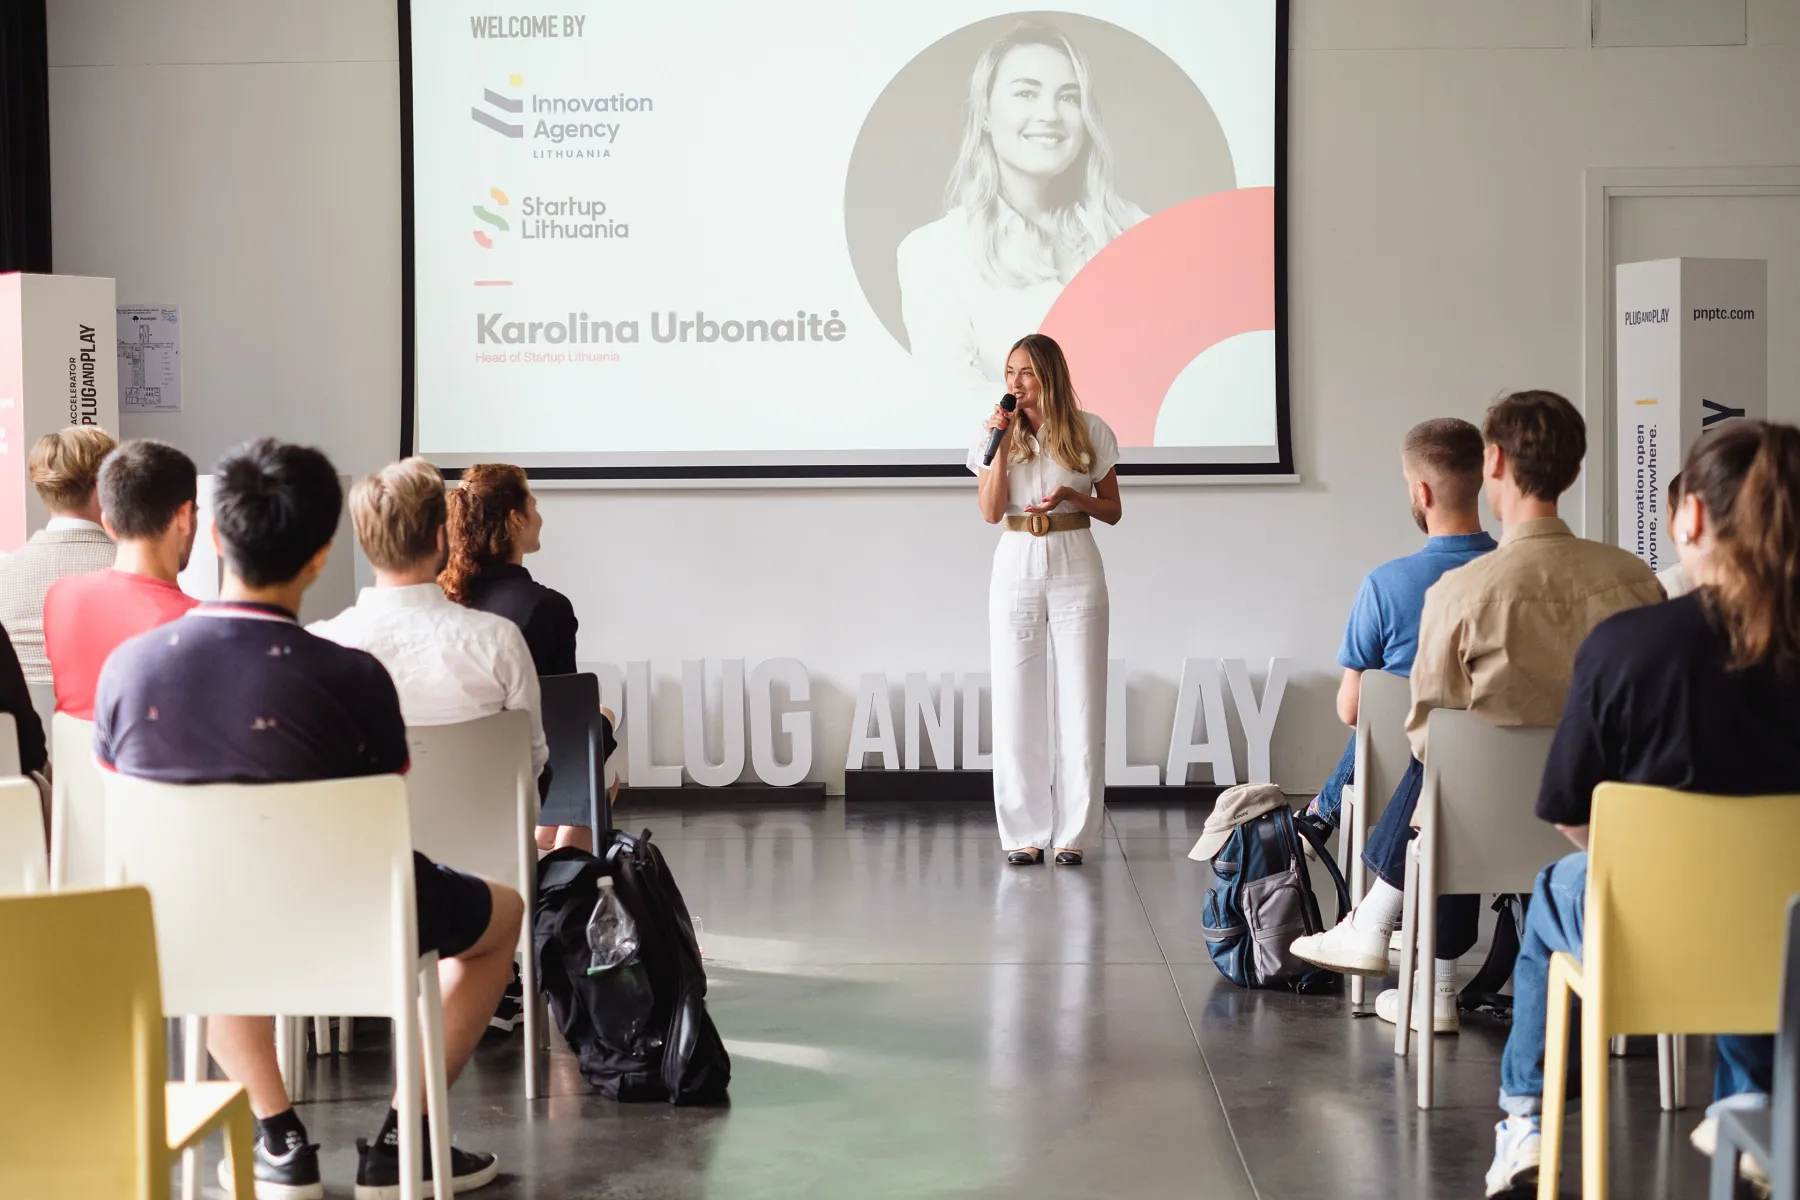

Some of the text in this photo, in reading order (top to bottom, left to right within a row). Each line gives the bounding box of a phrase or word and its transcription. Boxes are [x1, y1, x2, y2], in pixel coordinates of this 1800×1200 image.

[470, 15, 586, 38] WELCOME BY
[532, 93, 654, 114] Innovation
[533, 120, 620, 143] Agency
[533, 149, 612, 159] LITHUANIA
[521, 196, 607, 221] Startup
[521, 219, 630, 239] Lithuania
[1693, 308, 1755, 321] pnptc.com
[476, 309, 847, 345] Karolina Urbonaitė
[475, 352, 620, 365] Head of Startup Lithuania
[69, 357, 78, 425] ACCELERATOR
[1635, 424, 1646, 555] innovation open
[1647, 424, 1659, 572] nyone, anywhere.
[1105, 657, 1293, 786] LAY
